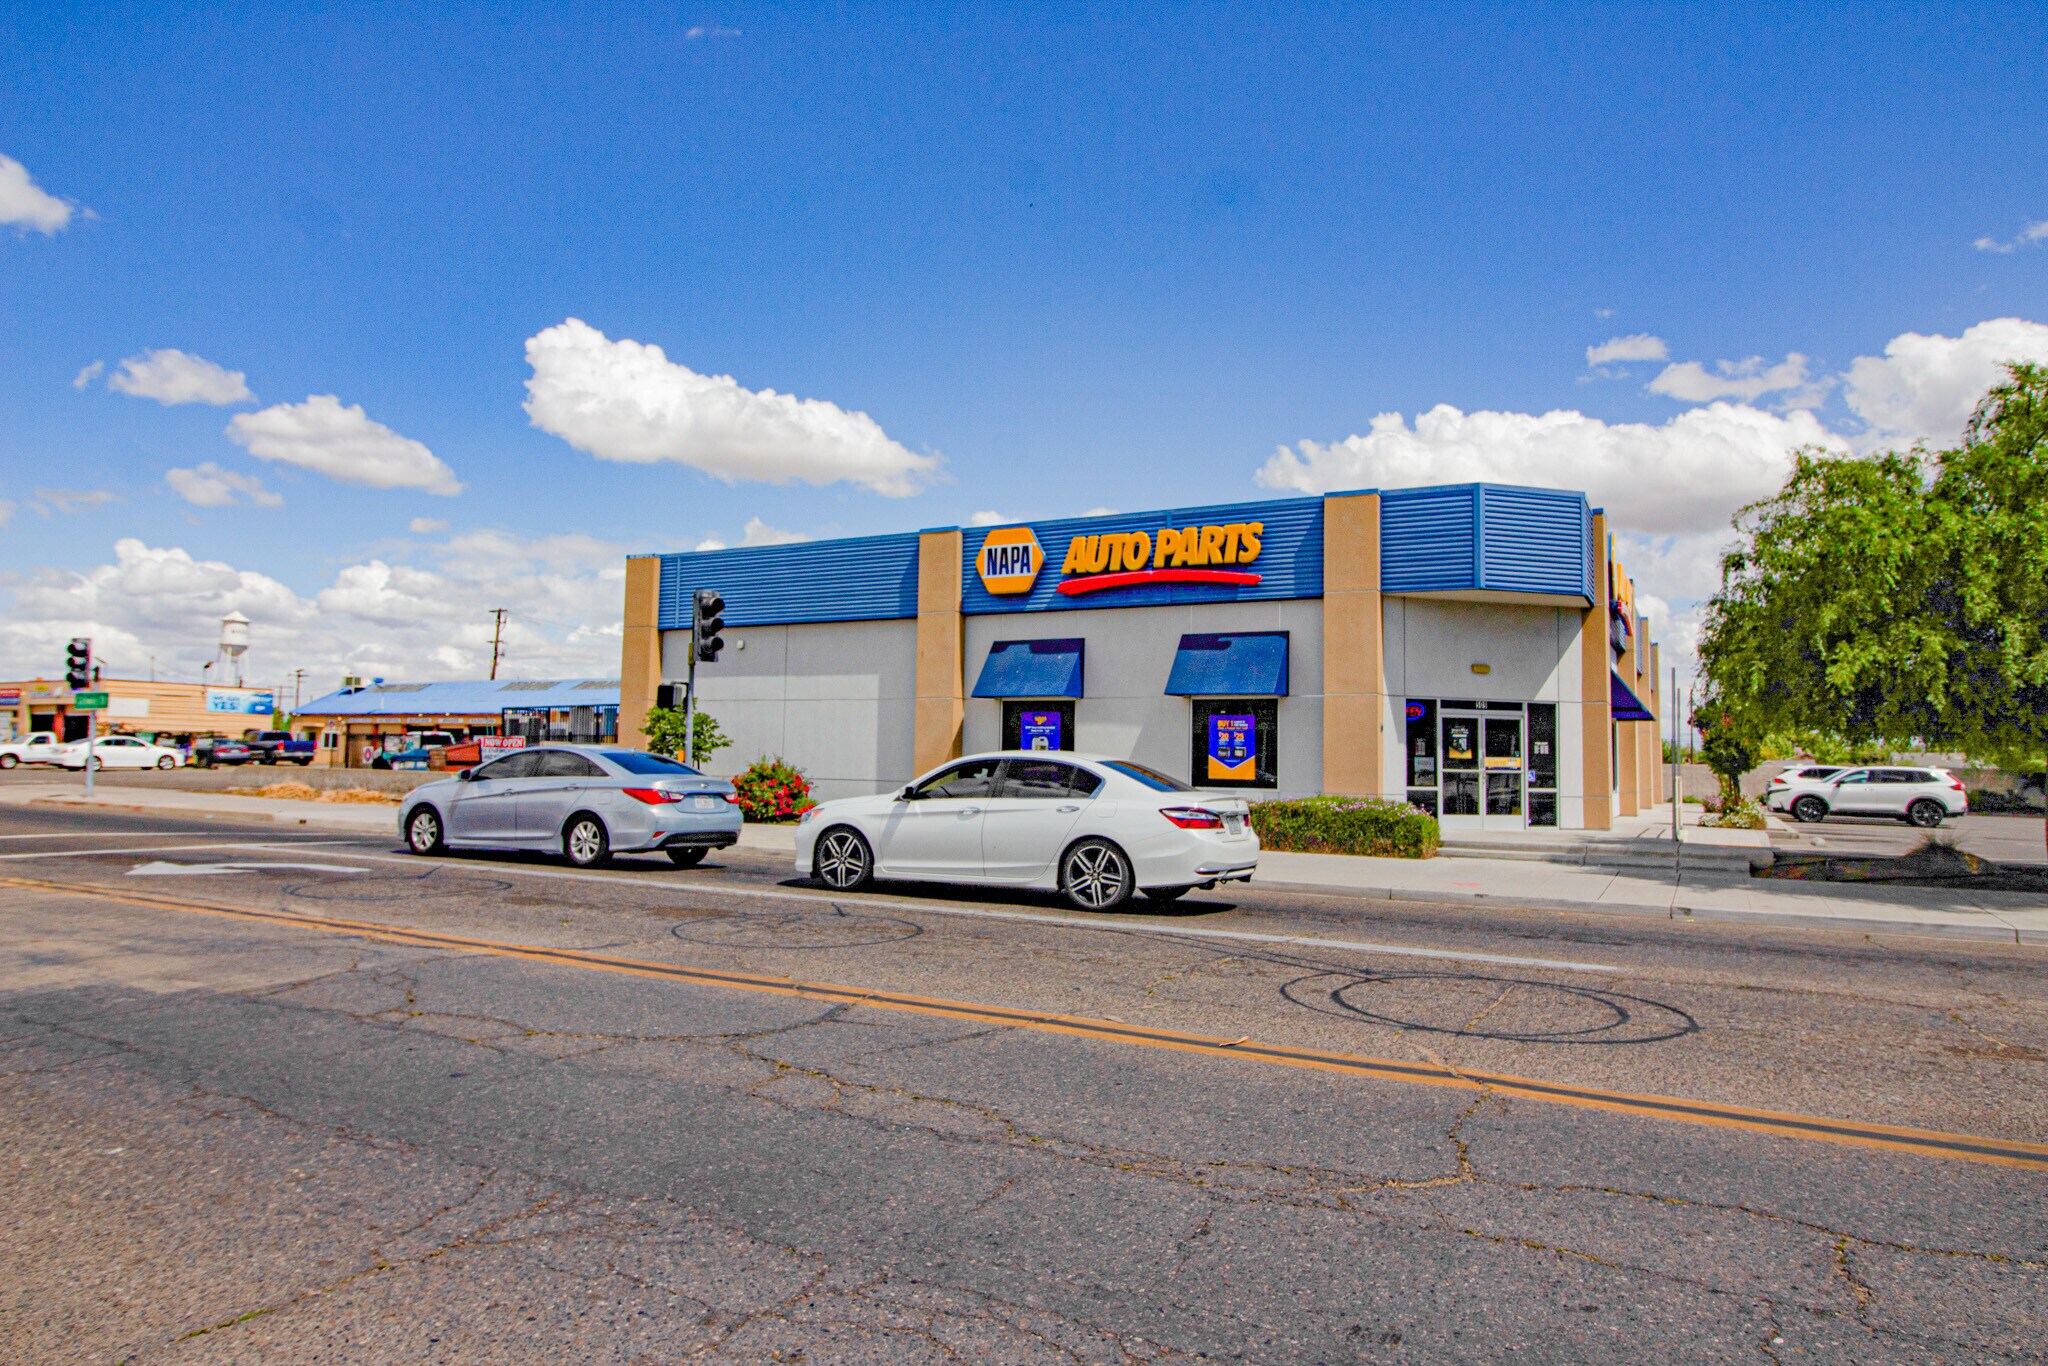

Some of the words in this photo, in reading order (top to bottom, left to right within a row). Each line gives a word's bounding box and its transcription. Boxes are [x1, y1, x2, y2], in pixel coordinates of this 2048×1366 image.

[986, 545, 1032, 576] NAPA
[1061, 531, 1151, 575] AUTO
[1153, 521, 1265, 568] PARTS
[485, 739, 502, 748] NOW
[502, 739, 523, 748] OPEN
